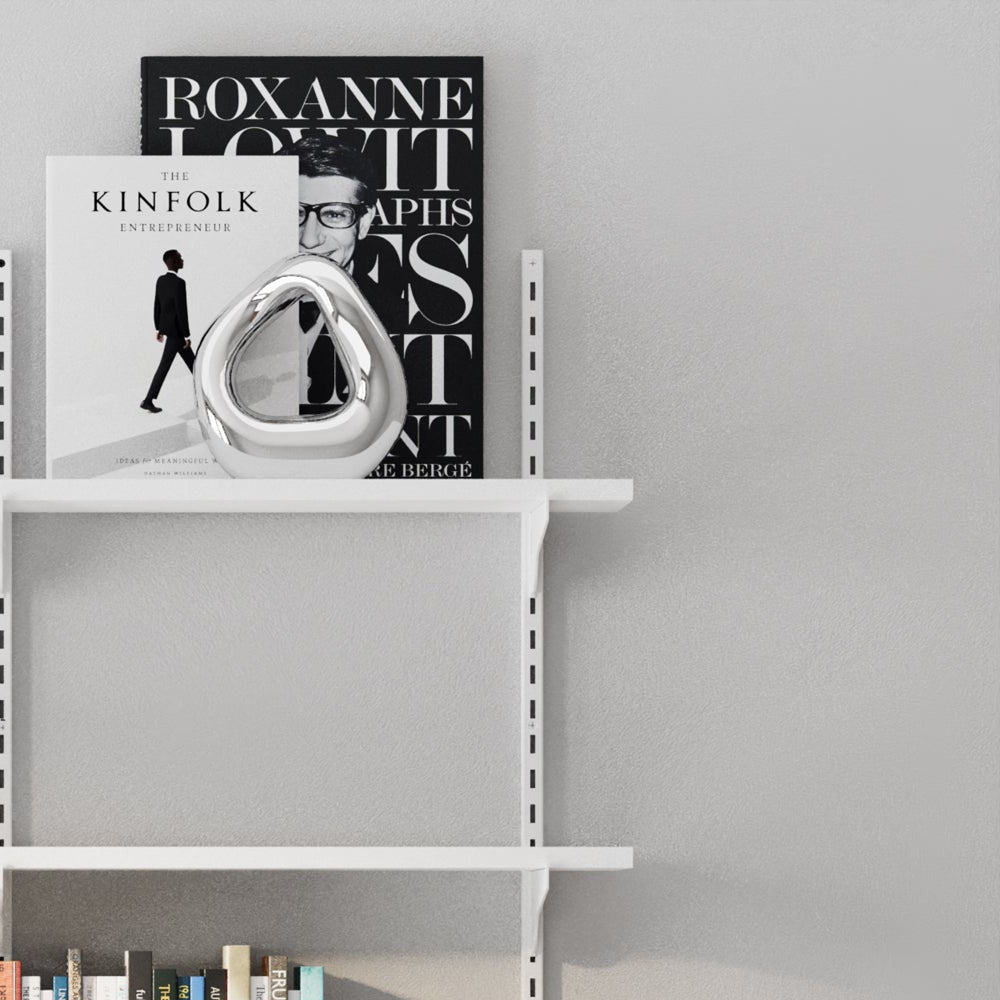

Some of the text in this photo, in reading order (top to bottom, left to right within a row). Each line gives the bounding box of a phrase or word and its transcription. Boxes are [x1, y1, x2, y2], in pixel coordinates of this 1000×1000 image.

[159, 76, 474, 121] ROXANNE
[161, 171, 189, 181] THE
[91, 190, 258, 213] KINFOLK
[120, 223, 231, 232] ENTREPRENEUR
[402, 461, 472, 477] BERGÉ
[180, 985, 189, 1000] P6)
